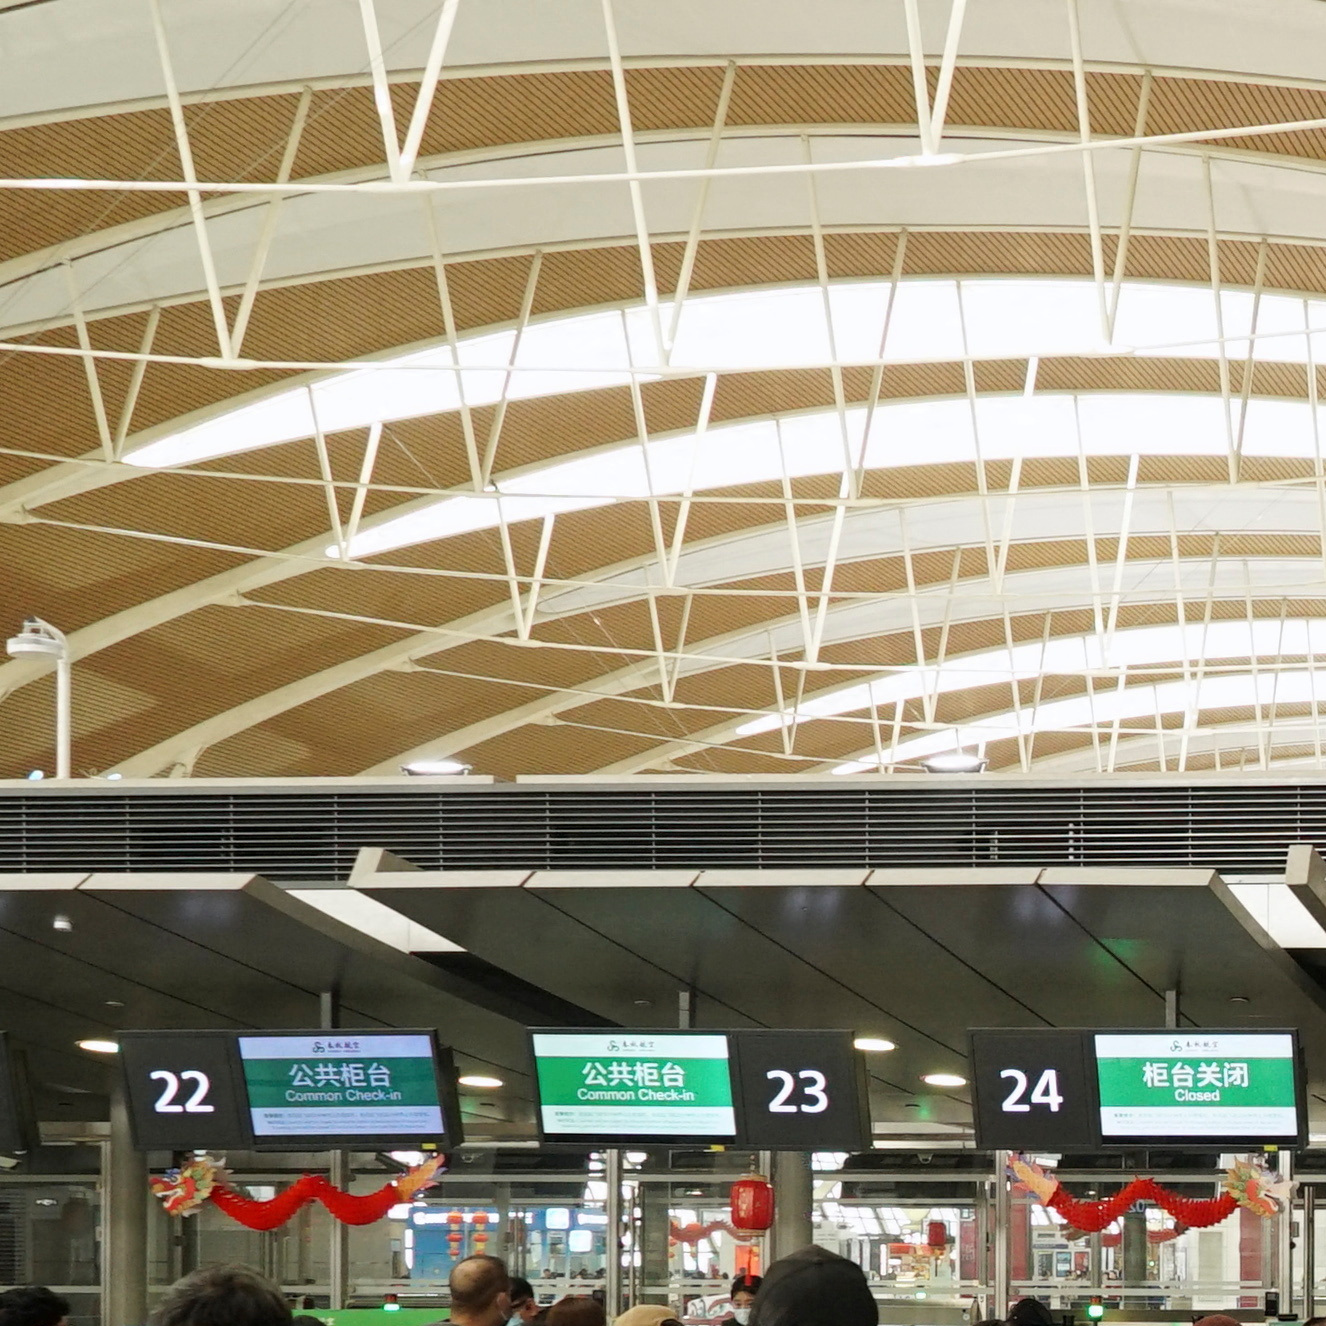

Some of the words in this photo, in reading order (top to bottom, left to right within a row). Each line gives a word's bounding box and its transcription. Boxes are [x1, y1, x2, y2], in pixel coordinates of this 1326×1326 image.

[289, 1063, 391, 1087] 公共柜台
[582, 1062, 685, 1087] 公共柜台
[1143, 1062, 1248, 1087] 柜台关闭
[150, 1071, 214, 1112] 22
[285, 1090, 343, 1101] Common
[346, 1089, 401, 1101] Check-in
[577, 1089, 634, 1100] Common
[638, 1089, 694, 1101] Check-in
[767, 1070, 828, 1113] 23
[1000, 1069, 1063, 1112] 24
[1175, 1089, 1220, 1101] Closed
